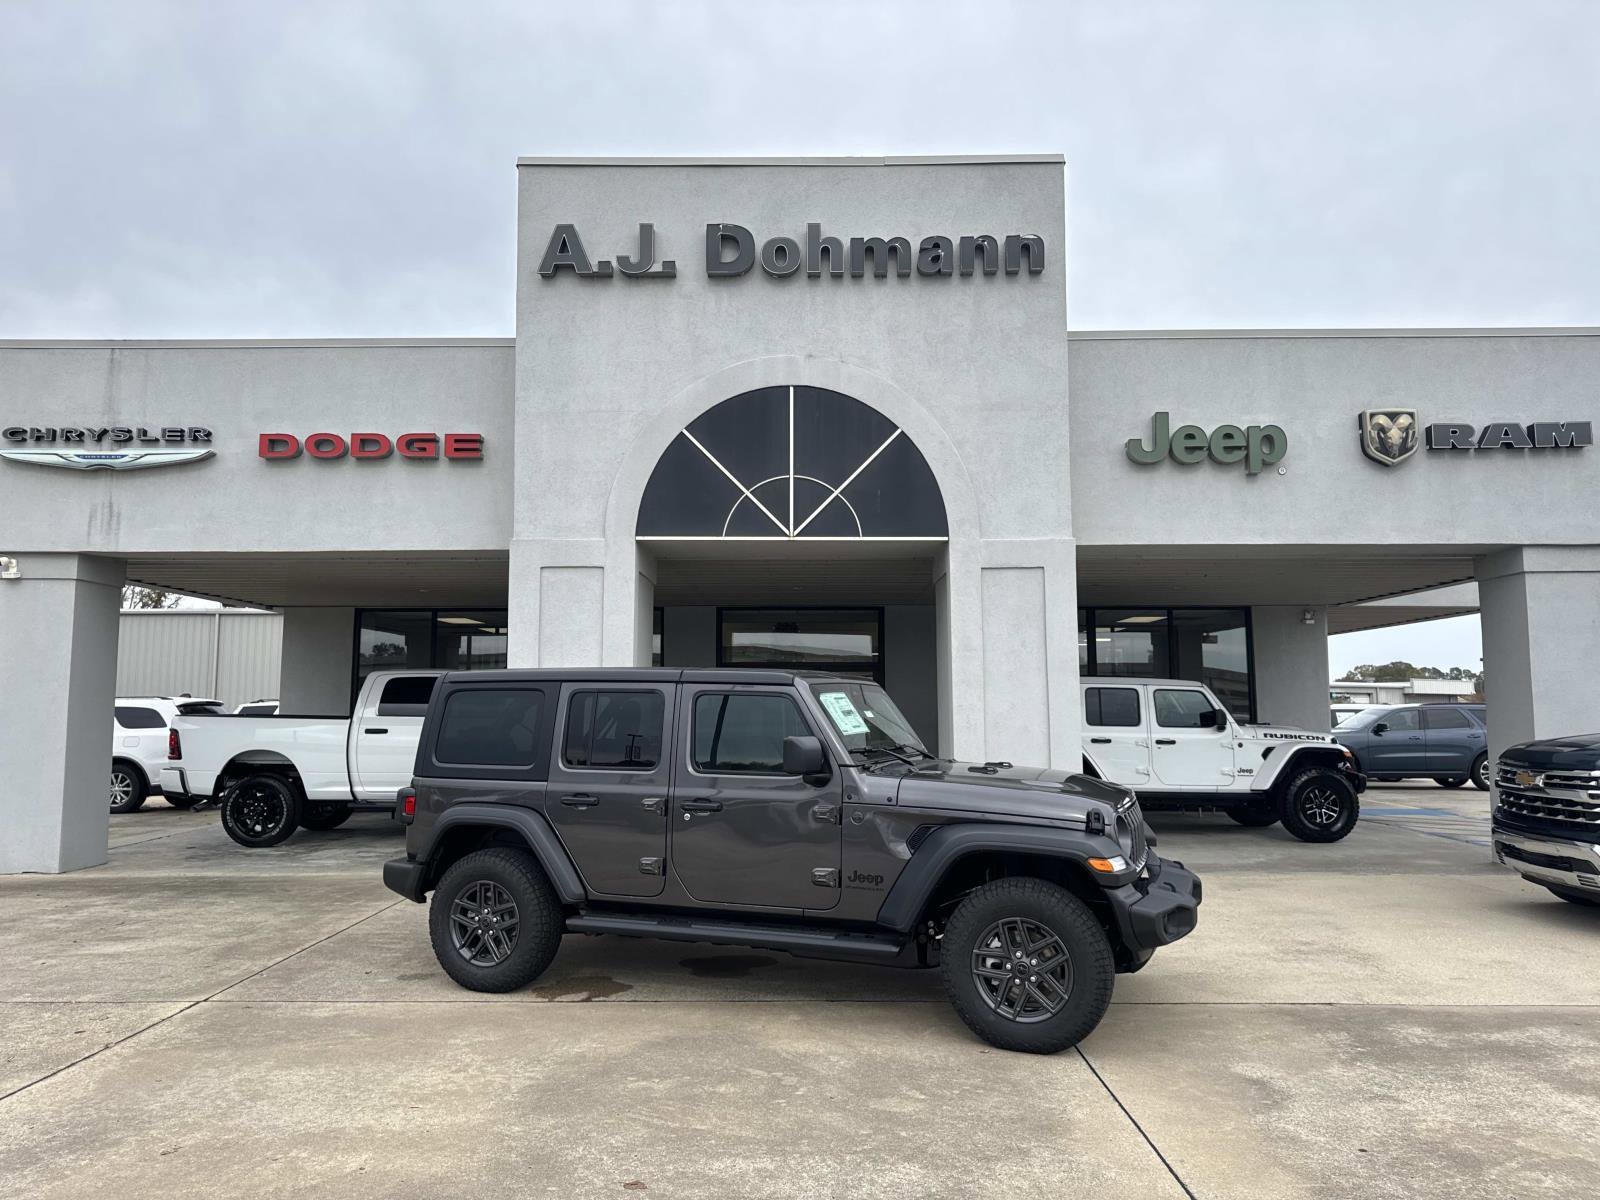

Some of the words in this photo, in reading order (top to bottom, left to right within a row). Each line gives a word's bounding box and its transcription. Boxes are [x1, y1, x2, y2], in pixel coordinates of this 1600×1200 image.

[538, 223, 676, 279] A.J.
[706, 222, 1045, 279] Dohmann
[2, 426, 213, 442] CHRYSLER
[258, 432, 484, 460] DODGE
[1126, 411, 1288, 475] Jeep
[1426, 421, 1593, 451] RAM
[1263, 732, 1326, 742] RUBICON
[847, 870, 884, 886] Jeep
